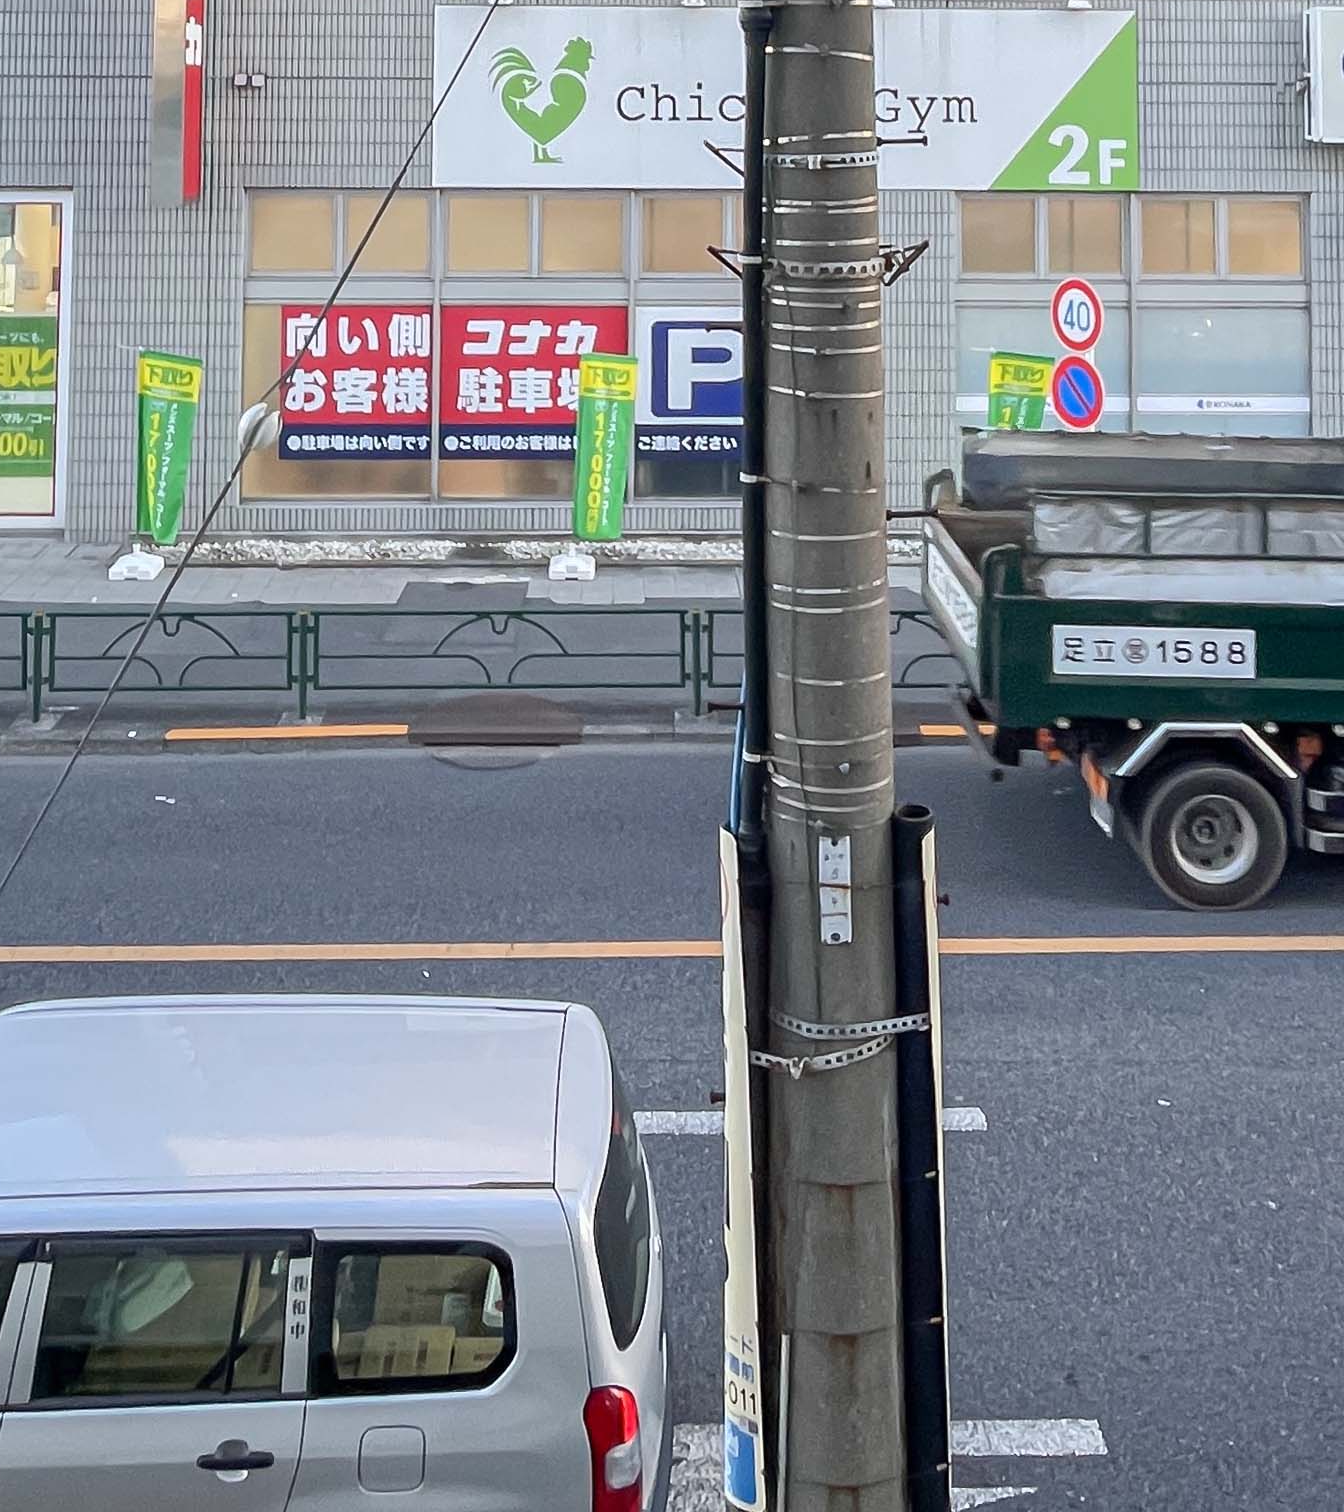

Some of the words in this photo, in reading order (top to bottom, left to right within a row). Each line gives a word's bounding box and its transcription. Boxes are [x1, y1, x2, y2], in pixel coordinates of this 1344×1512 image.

[617, 82, 746, 121] Chic
[874, 88, 978, 133] Gym
[1048, 124, 1127, 185] 2F
[285, 313, 430, 358] 向い側
[462, 319, 598, 356] コナカ
[1063, 299, 1091, 331] 40
[285, 367, 428, 414] お客様
[668, 328, 744, 410] P
[459, 434, 578, 451] ご利用のお客様は
